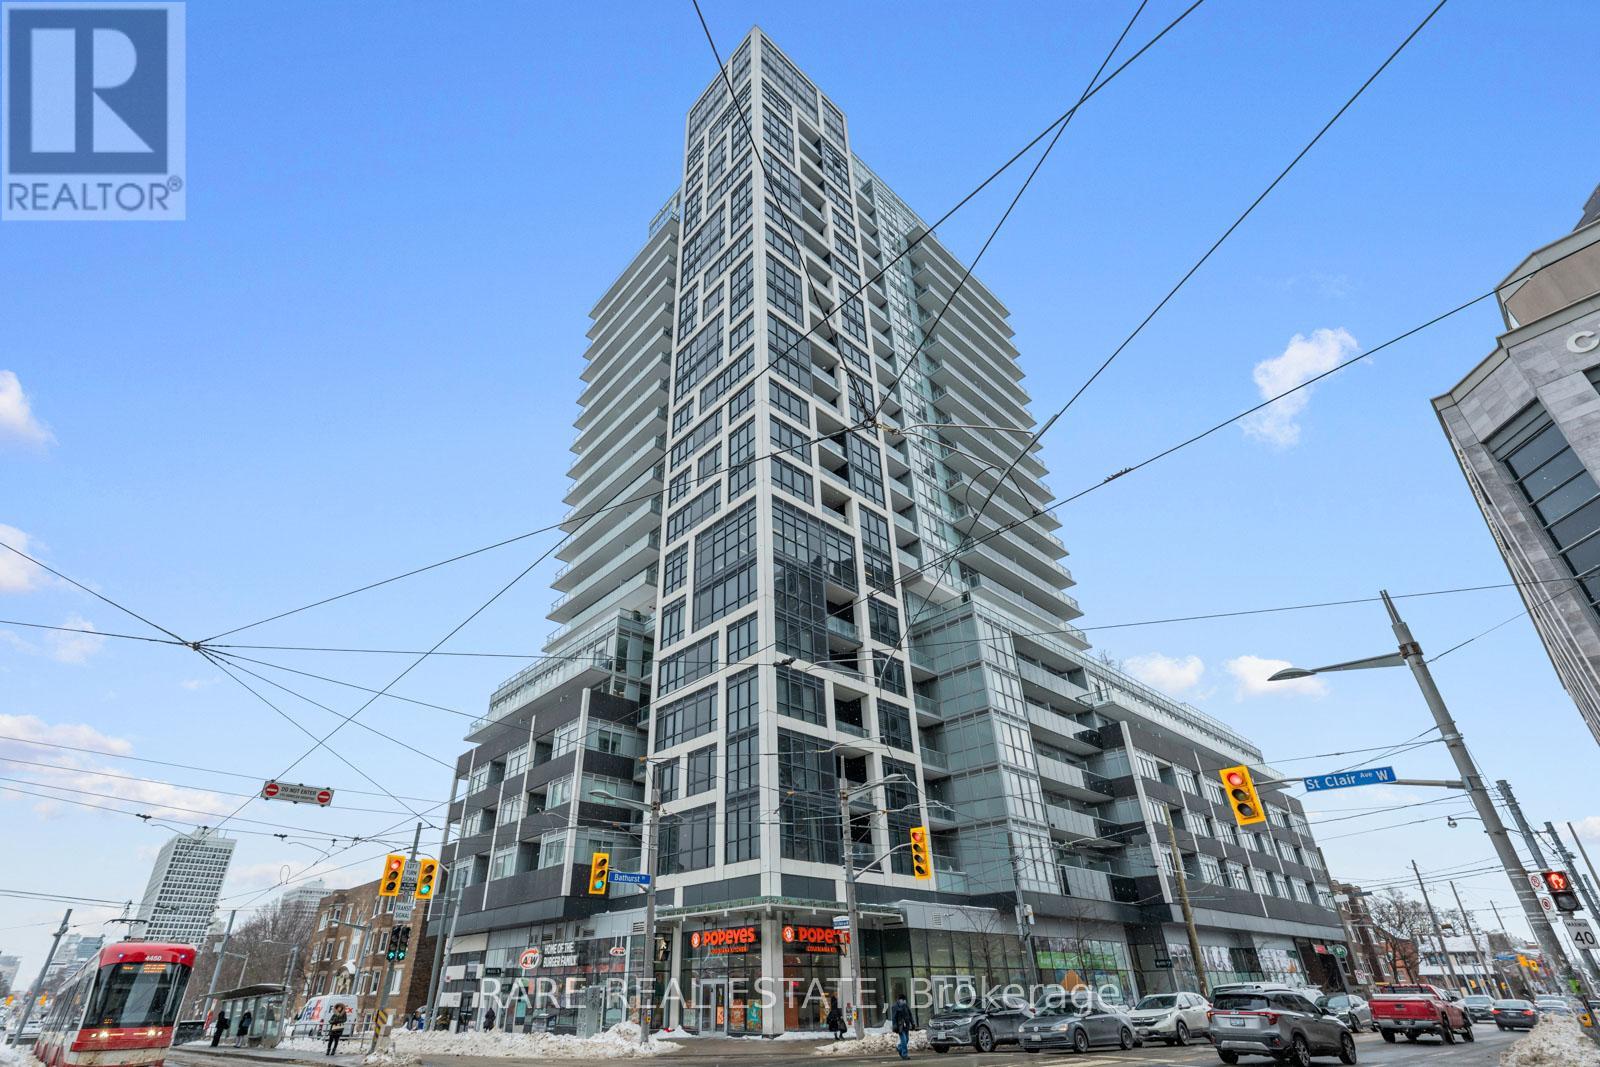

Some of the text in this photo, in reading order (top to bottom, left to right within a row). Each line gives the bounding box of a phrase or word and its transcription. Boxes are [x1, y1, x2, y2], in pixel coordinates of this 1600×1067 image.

[1306, 769, 1388, 790] St Clair Ave W
[614, 873, 640, 883] Bathurst
[703, 927, 756, 946] POPEYES
[1574, 931, 1595, 945] 40
[544, 942, 575, 955] HOME OF THE
[522, 956, 539, 966] A&W
[543, 955, 579, 968] BURGER FAMILY
